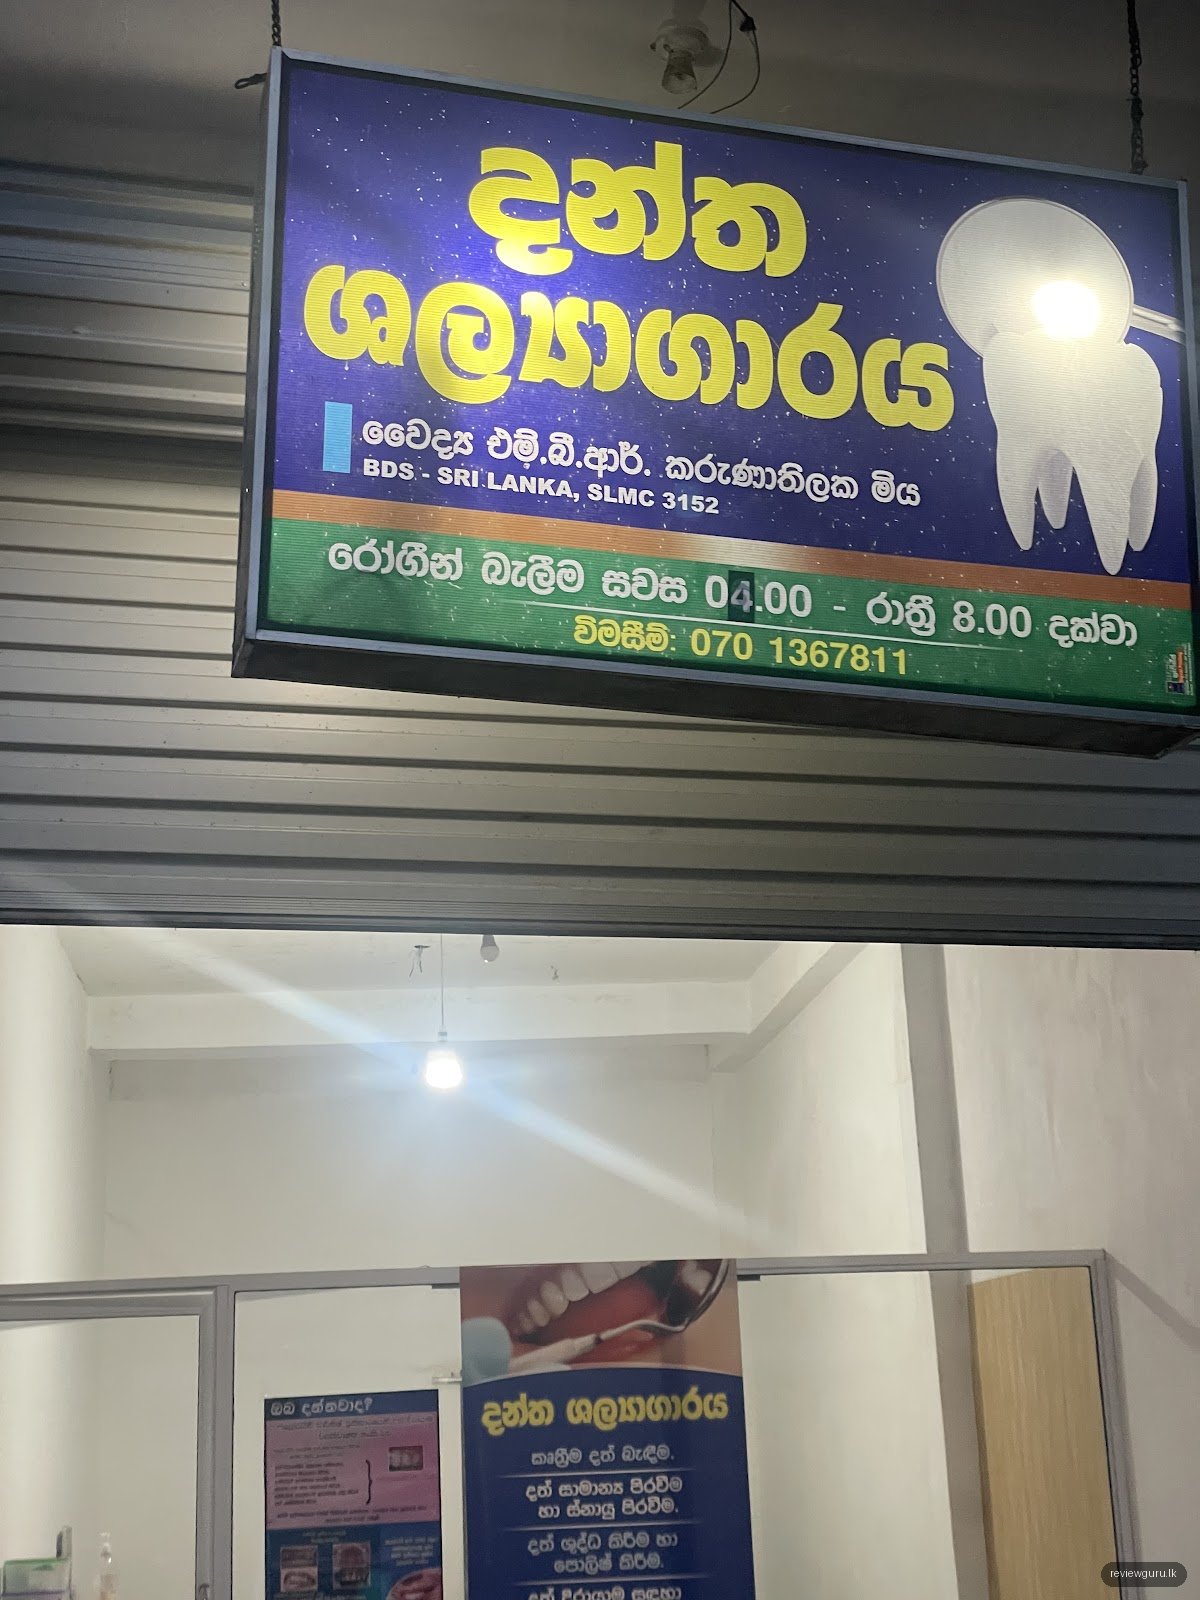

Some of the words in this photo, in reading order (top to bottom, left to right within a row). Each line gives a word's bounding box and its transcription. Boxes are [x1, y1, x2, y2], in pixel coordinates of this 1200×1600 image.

[468, 141, 807, 278] දන්ත
[303, 264, 957, 433] ශල්‍යාගාරය
[362, 417, 474, 460] වෛද්‍ය
[664, 453, 859, 503] කරුණාතිලක
[870, 469, 921, 507] මිය
[363, 458, 415, 481] BDS
[437, 466, 479, 488] SRI
[487, 471, 580, 502] LANKA,
[587, 483, 655, 507] SLMC
[662, 491, 720, 514] 3152
[328, 538, 464, 581] රෝගීන්
[481, 551, 585, 596] බැලීම
[601, 567, 689, 604] සවස
[705, 575, 812, 618] 04.00
[866, 591, 937, 637] රාත්‍රී
[952, 600, 1032, 638] 8.00
[1048, 611, 1139, 648] දක්වා
[573, 614, 677, 652] විමසීම්:
[691, 627, 754, 660] 070
[769, 636, 907, 675] 1367811
[481, 1392, 555, 1437] දන්ත
[566, 1385, 729, 1431] ශල්‍යාගාරය
[588, 1444, 616, 1467] දත්
[525, 1479, 553, 1502] දත්
[630, 1475, 683, 1495] පිරවීම
[538, 1504, 561, 1519] හා
[527, 1533, 555, 1556] දත්
[656, 1532, 679, 1548] හා
